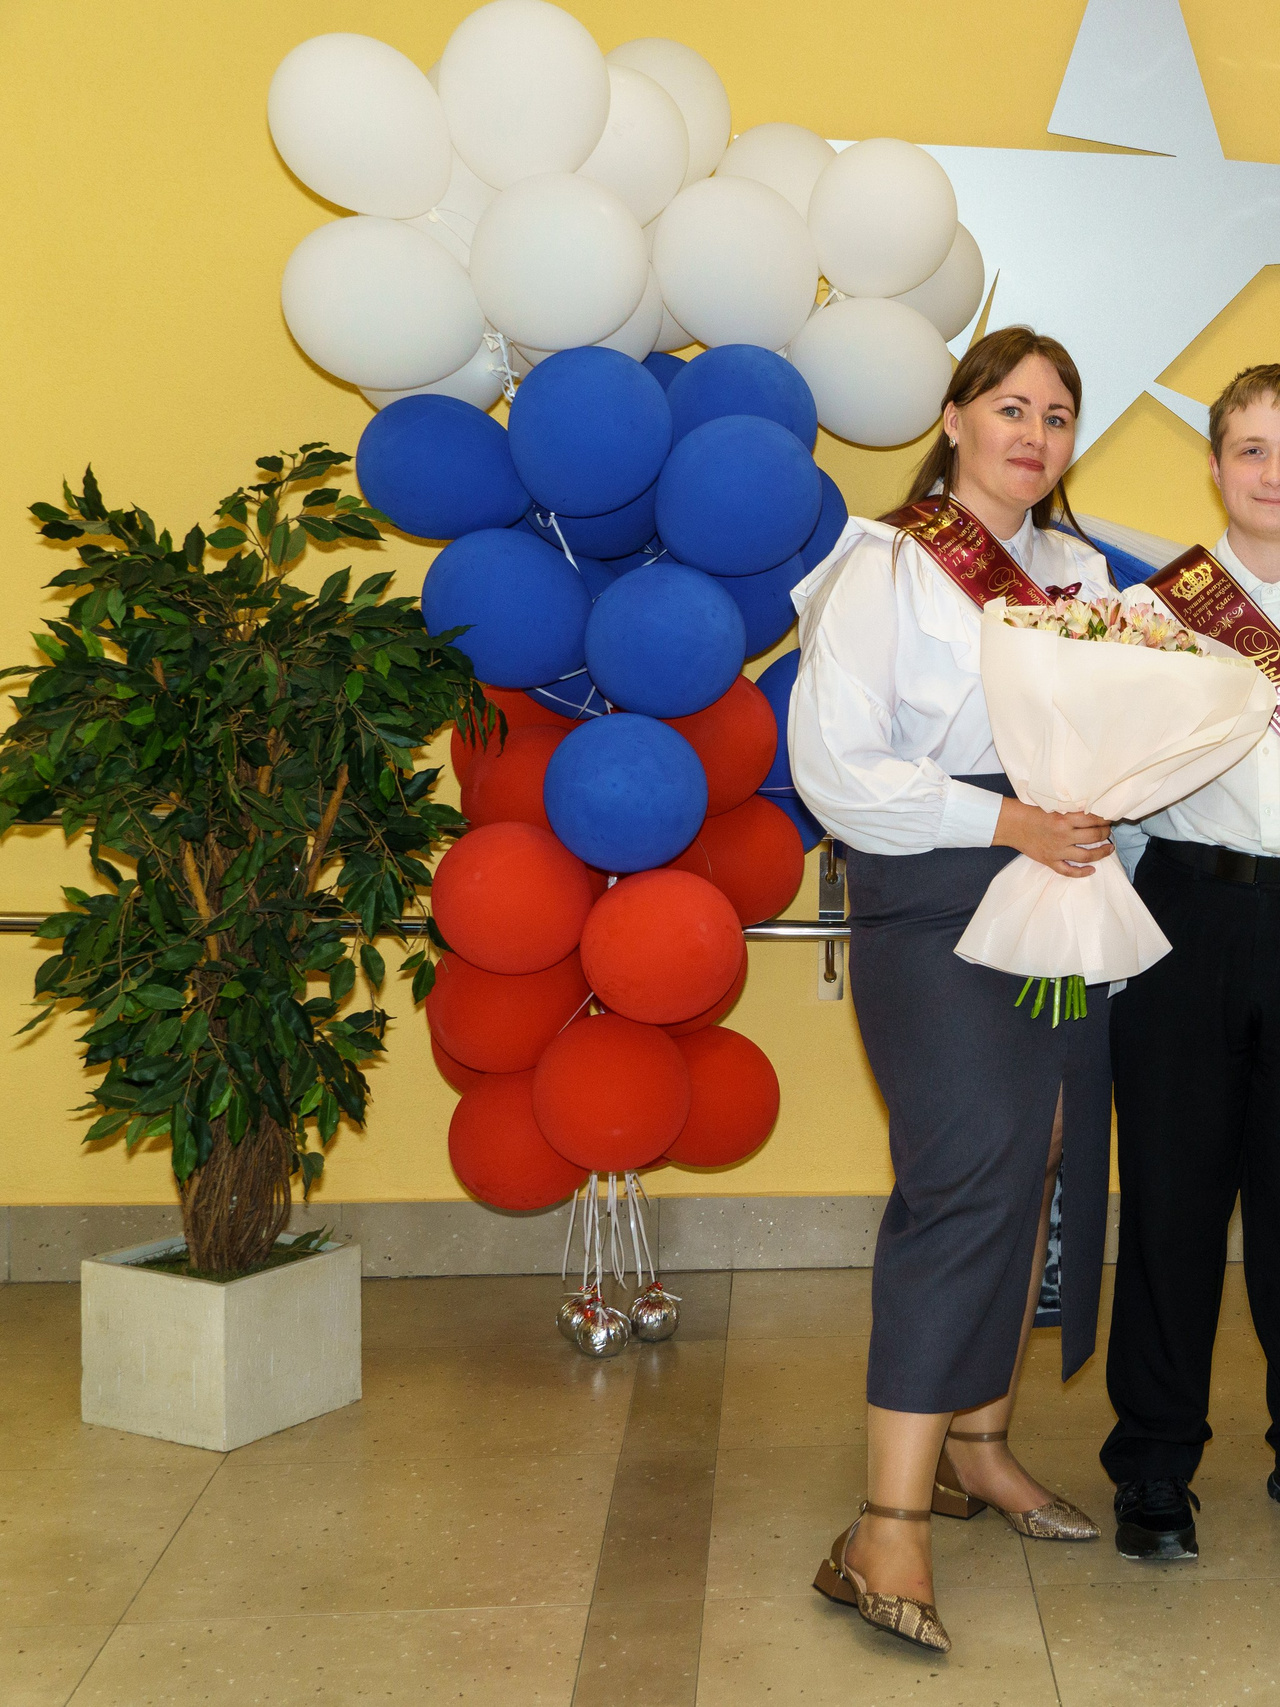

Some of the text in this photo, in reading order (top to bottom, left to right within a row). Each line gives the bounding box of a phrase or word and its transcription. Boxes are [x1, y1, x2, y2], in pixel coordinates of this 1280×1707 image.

[952, 556, 962, 567] 11
[969, 534, 987, 553] класс
[1183, 577, 1229, 617] Лучший выпуск
[1193, 598, 1214, 618] истории
[1214, 582, 1232, 599] школы
[1197, 616, 1206, 627] 11
[1215, 591, 1235, 611] класс
